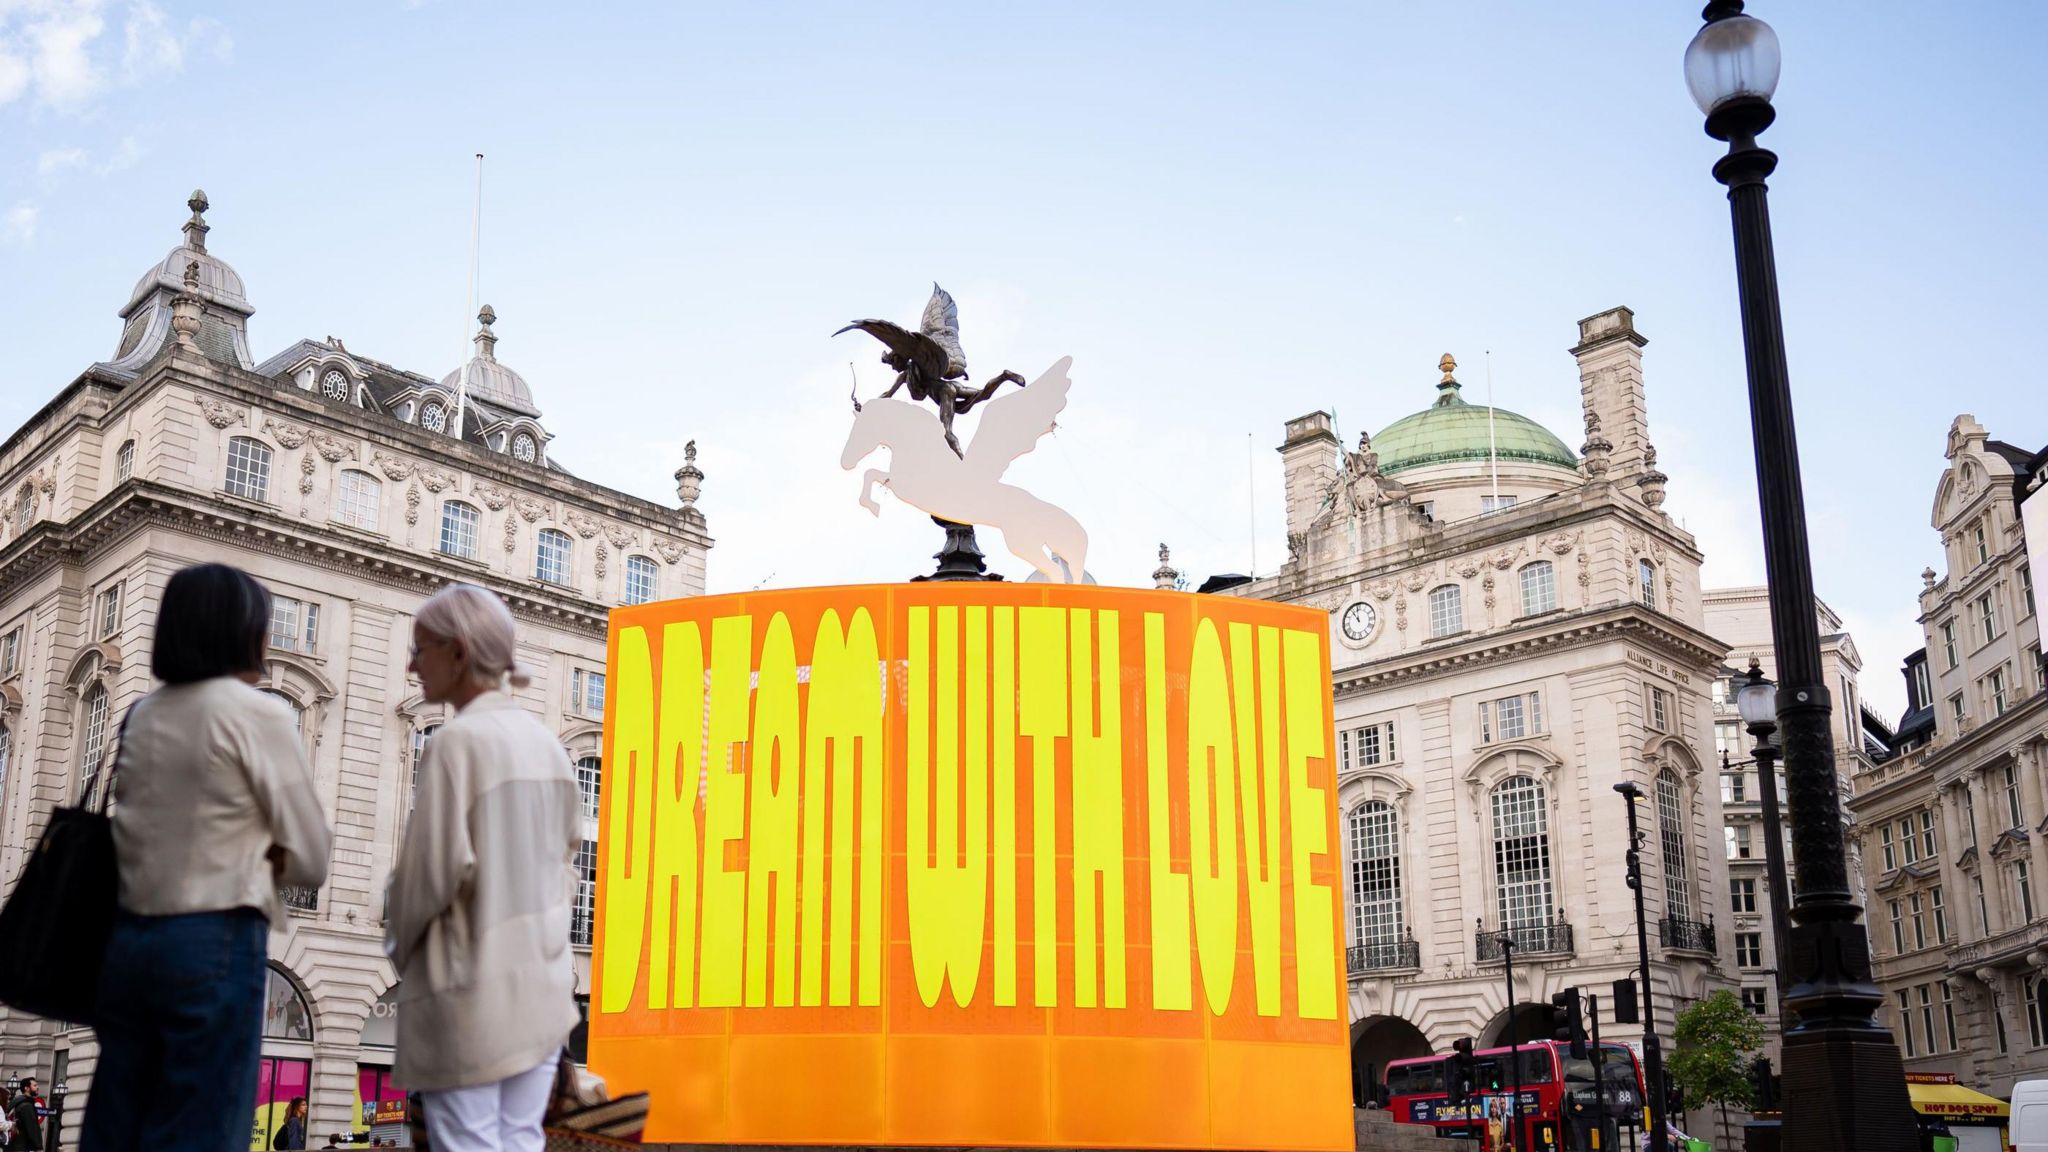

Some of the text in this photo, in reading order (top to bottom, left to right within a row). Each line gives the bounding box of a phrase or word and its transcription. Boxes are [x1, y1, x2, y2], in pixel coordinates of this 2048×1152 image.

[1626, 649, 1690, 685] ALLIANCE LIFE OFFICE
[602, 605, 1337, 1019] DREAM WITH LOVE
[1619, 1090, 1632, 1102] 88
[1435, 1106, 1447, 1117] FLY
[1447, 1105, 1456, 1116] ME
[1460, 1104, 1482, 1116] MON
[1924, 1104, 1998, 1114] HOT DOG SPOT
